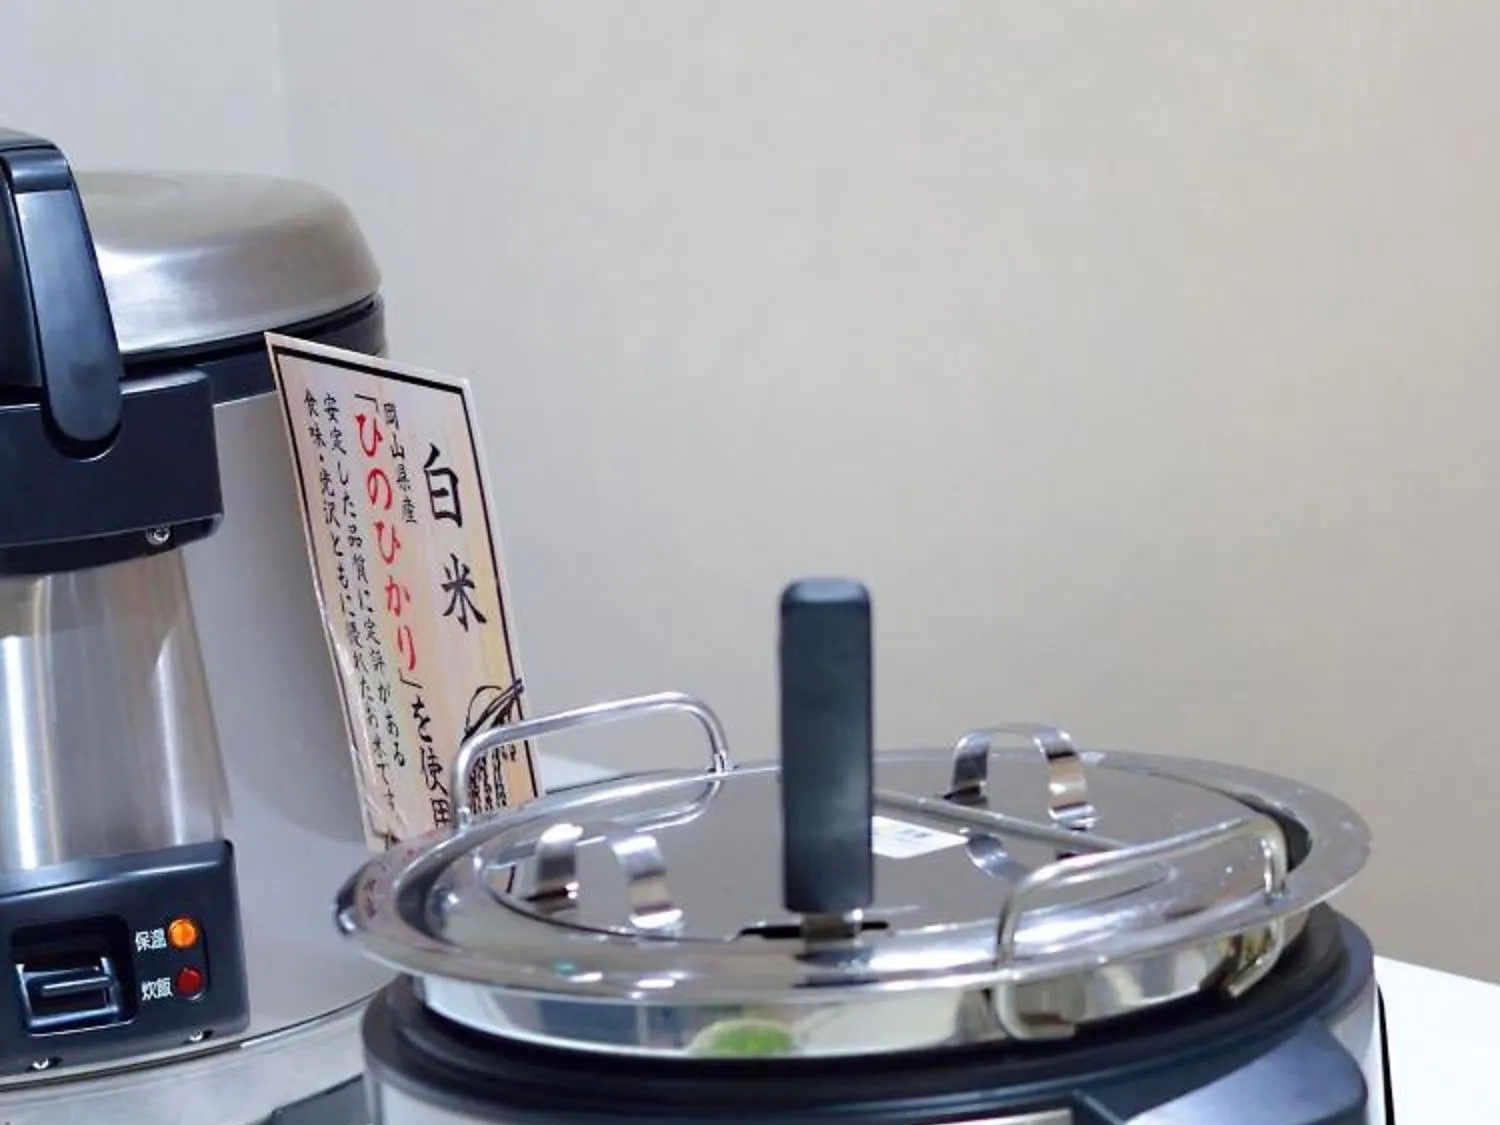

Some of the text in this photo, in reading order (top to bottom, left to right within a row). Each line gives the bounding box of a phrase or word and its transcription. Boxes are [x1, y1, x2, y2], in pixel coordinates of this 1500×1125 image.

[424, 442, 487, 632] 白米
[135, 928, 167, 952] 保温
[141, 977, 173, 1001] 炊飯
